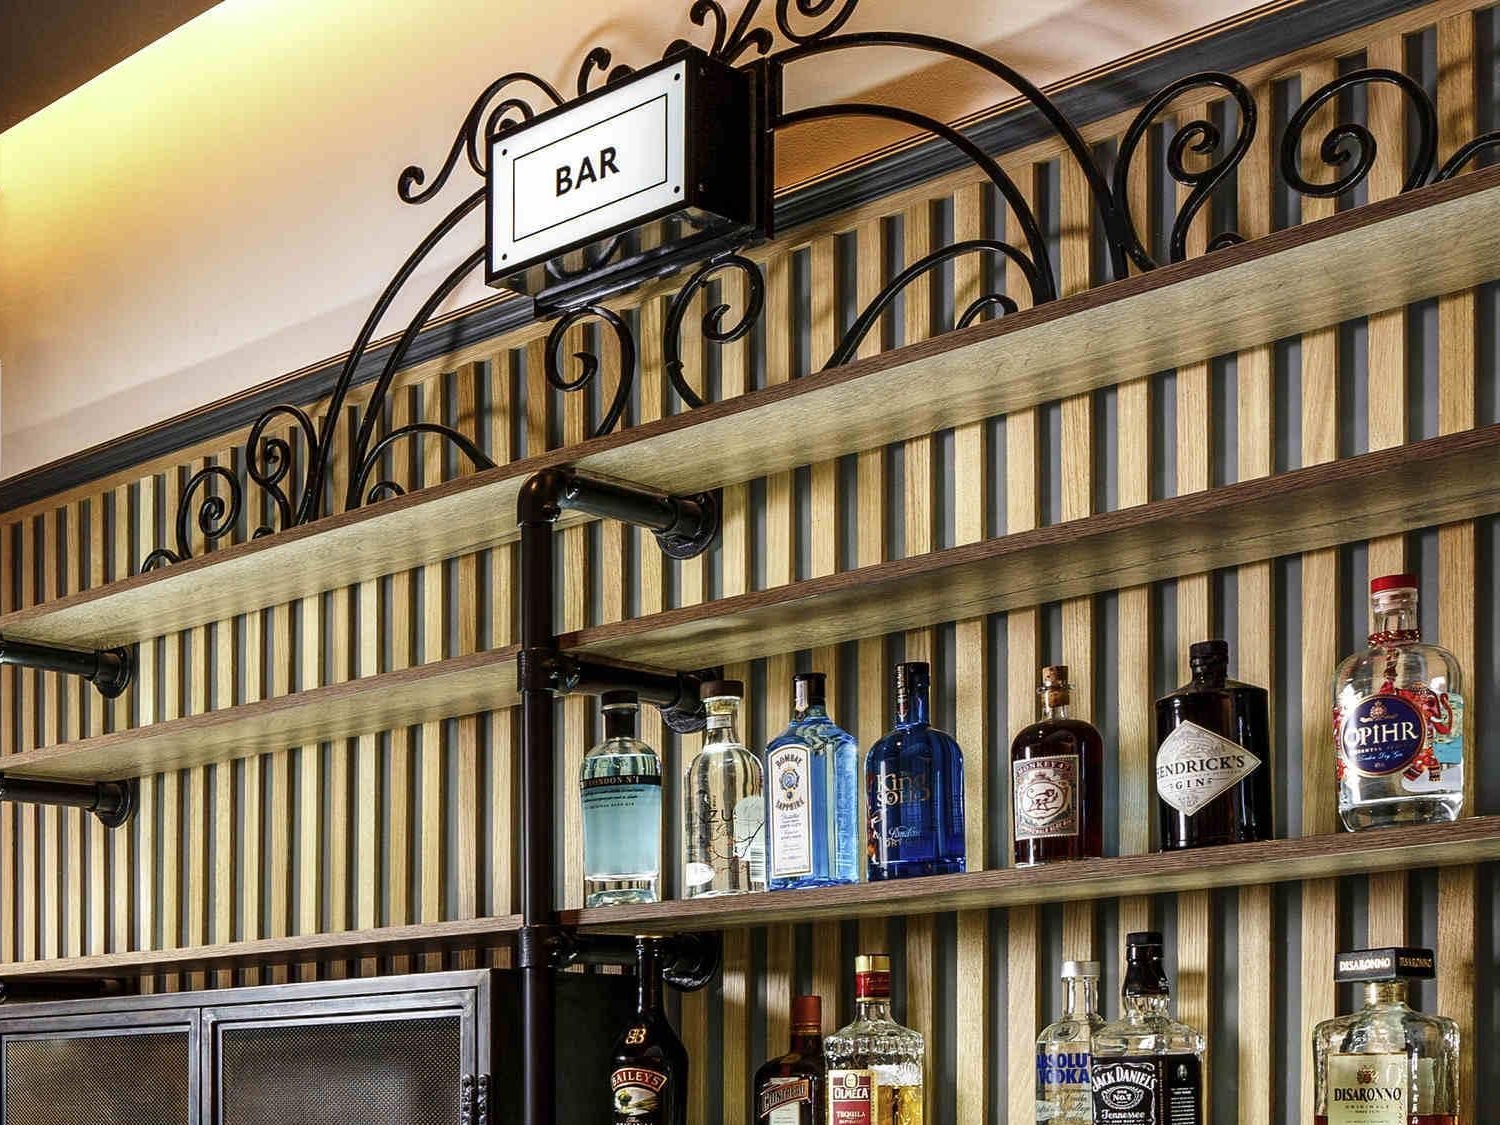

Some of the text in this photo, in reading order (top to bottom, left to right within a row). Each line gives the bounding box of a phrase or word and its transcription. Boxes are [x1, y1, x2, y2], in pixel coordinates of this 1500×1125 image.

[555, 146, 620, 197] BAR
[1344, 721, 1419, 746] OPIHR
[775, 754, 803, 769] BOMBAY
[1175, 777, 1204, 790] GIN
[775, 796, 805, 811] SAPPHIRE
[1339, 957, 1391, 972] DISARONNO
[612, 1071, 660, 1087] BAILEYS
[1040, 1069, 1090, 1084] VODKA
[1092, 1066, 1158, 1092] JACK DANIEL'S
[834, 1087, 869, 1099] OLMECA
[1334, 1087, 1402, 1103] DISARONNO
[836, 1111, 866, 1119] TEQUILA
[1101, 1109, 1146, 1120] Tennessee
